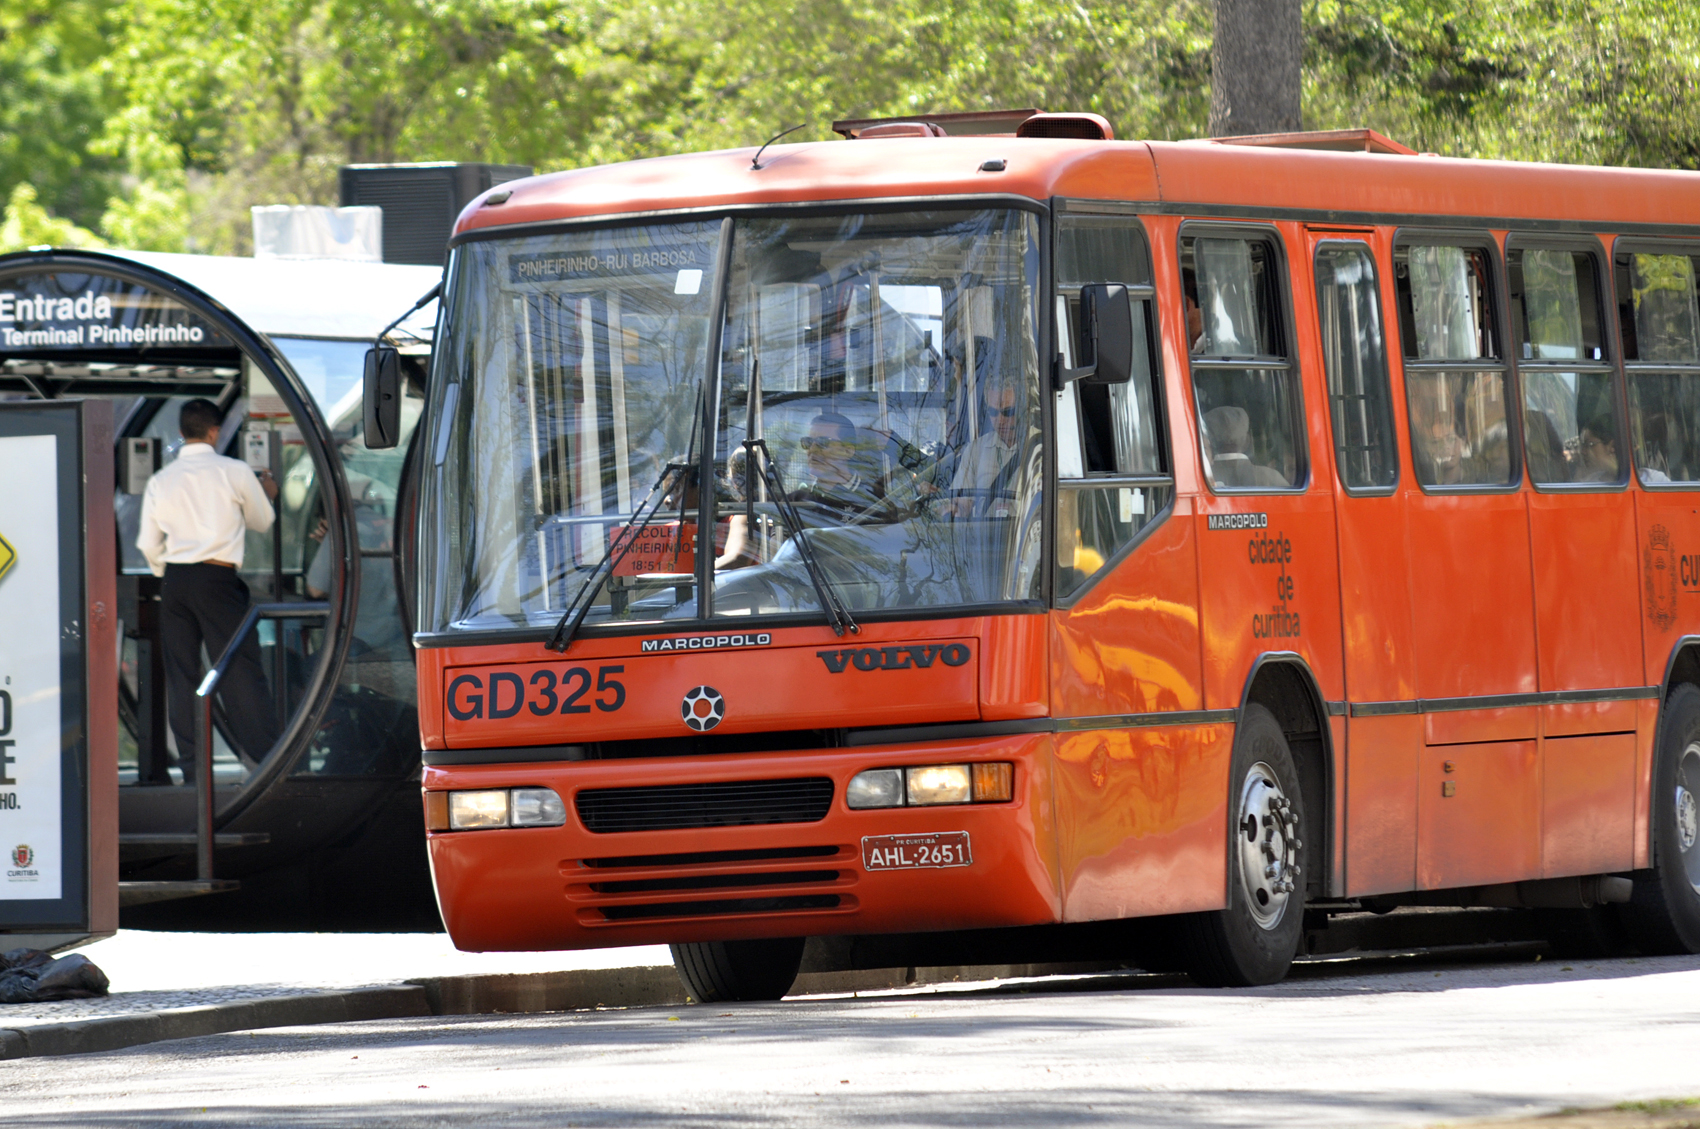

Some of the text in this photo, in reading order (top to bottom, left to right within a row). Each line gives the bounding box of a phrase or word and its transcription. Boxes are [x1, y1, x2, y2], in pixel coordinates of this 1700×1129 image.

[632, 250, 697, 268] BARBOSA
[0, 290, 112, 322] Entrada
[2, 322, 204, 346] Terminal Pinheirinho
[1208, 513, 1268, 530] MARCOPOLO
[1248, 532, 1292, 564] cidade
[631, 560, 662, 571] 18:51
[1680, 554, 1700, 587] CU
[1277, 570, 1294, 601] de
[1252, 604, 1301, 639] curitiba
[641, 634, 771, 652] MARCOPOLO
[816, 643, 972, 673] VOLVO
[447, 665, 626, 721] GD325
[7, 869, 39, 877] CURITIBA
